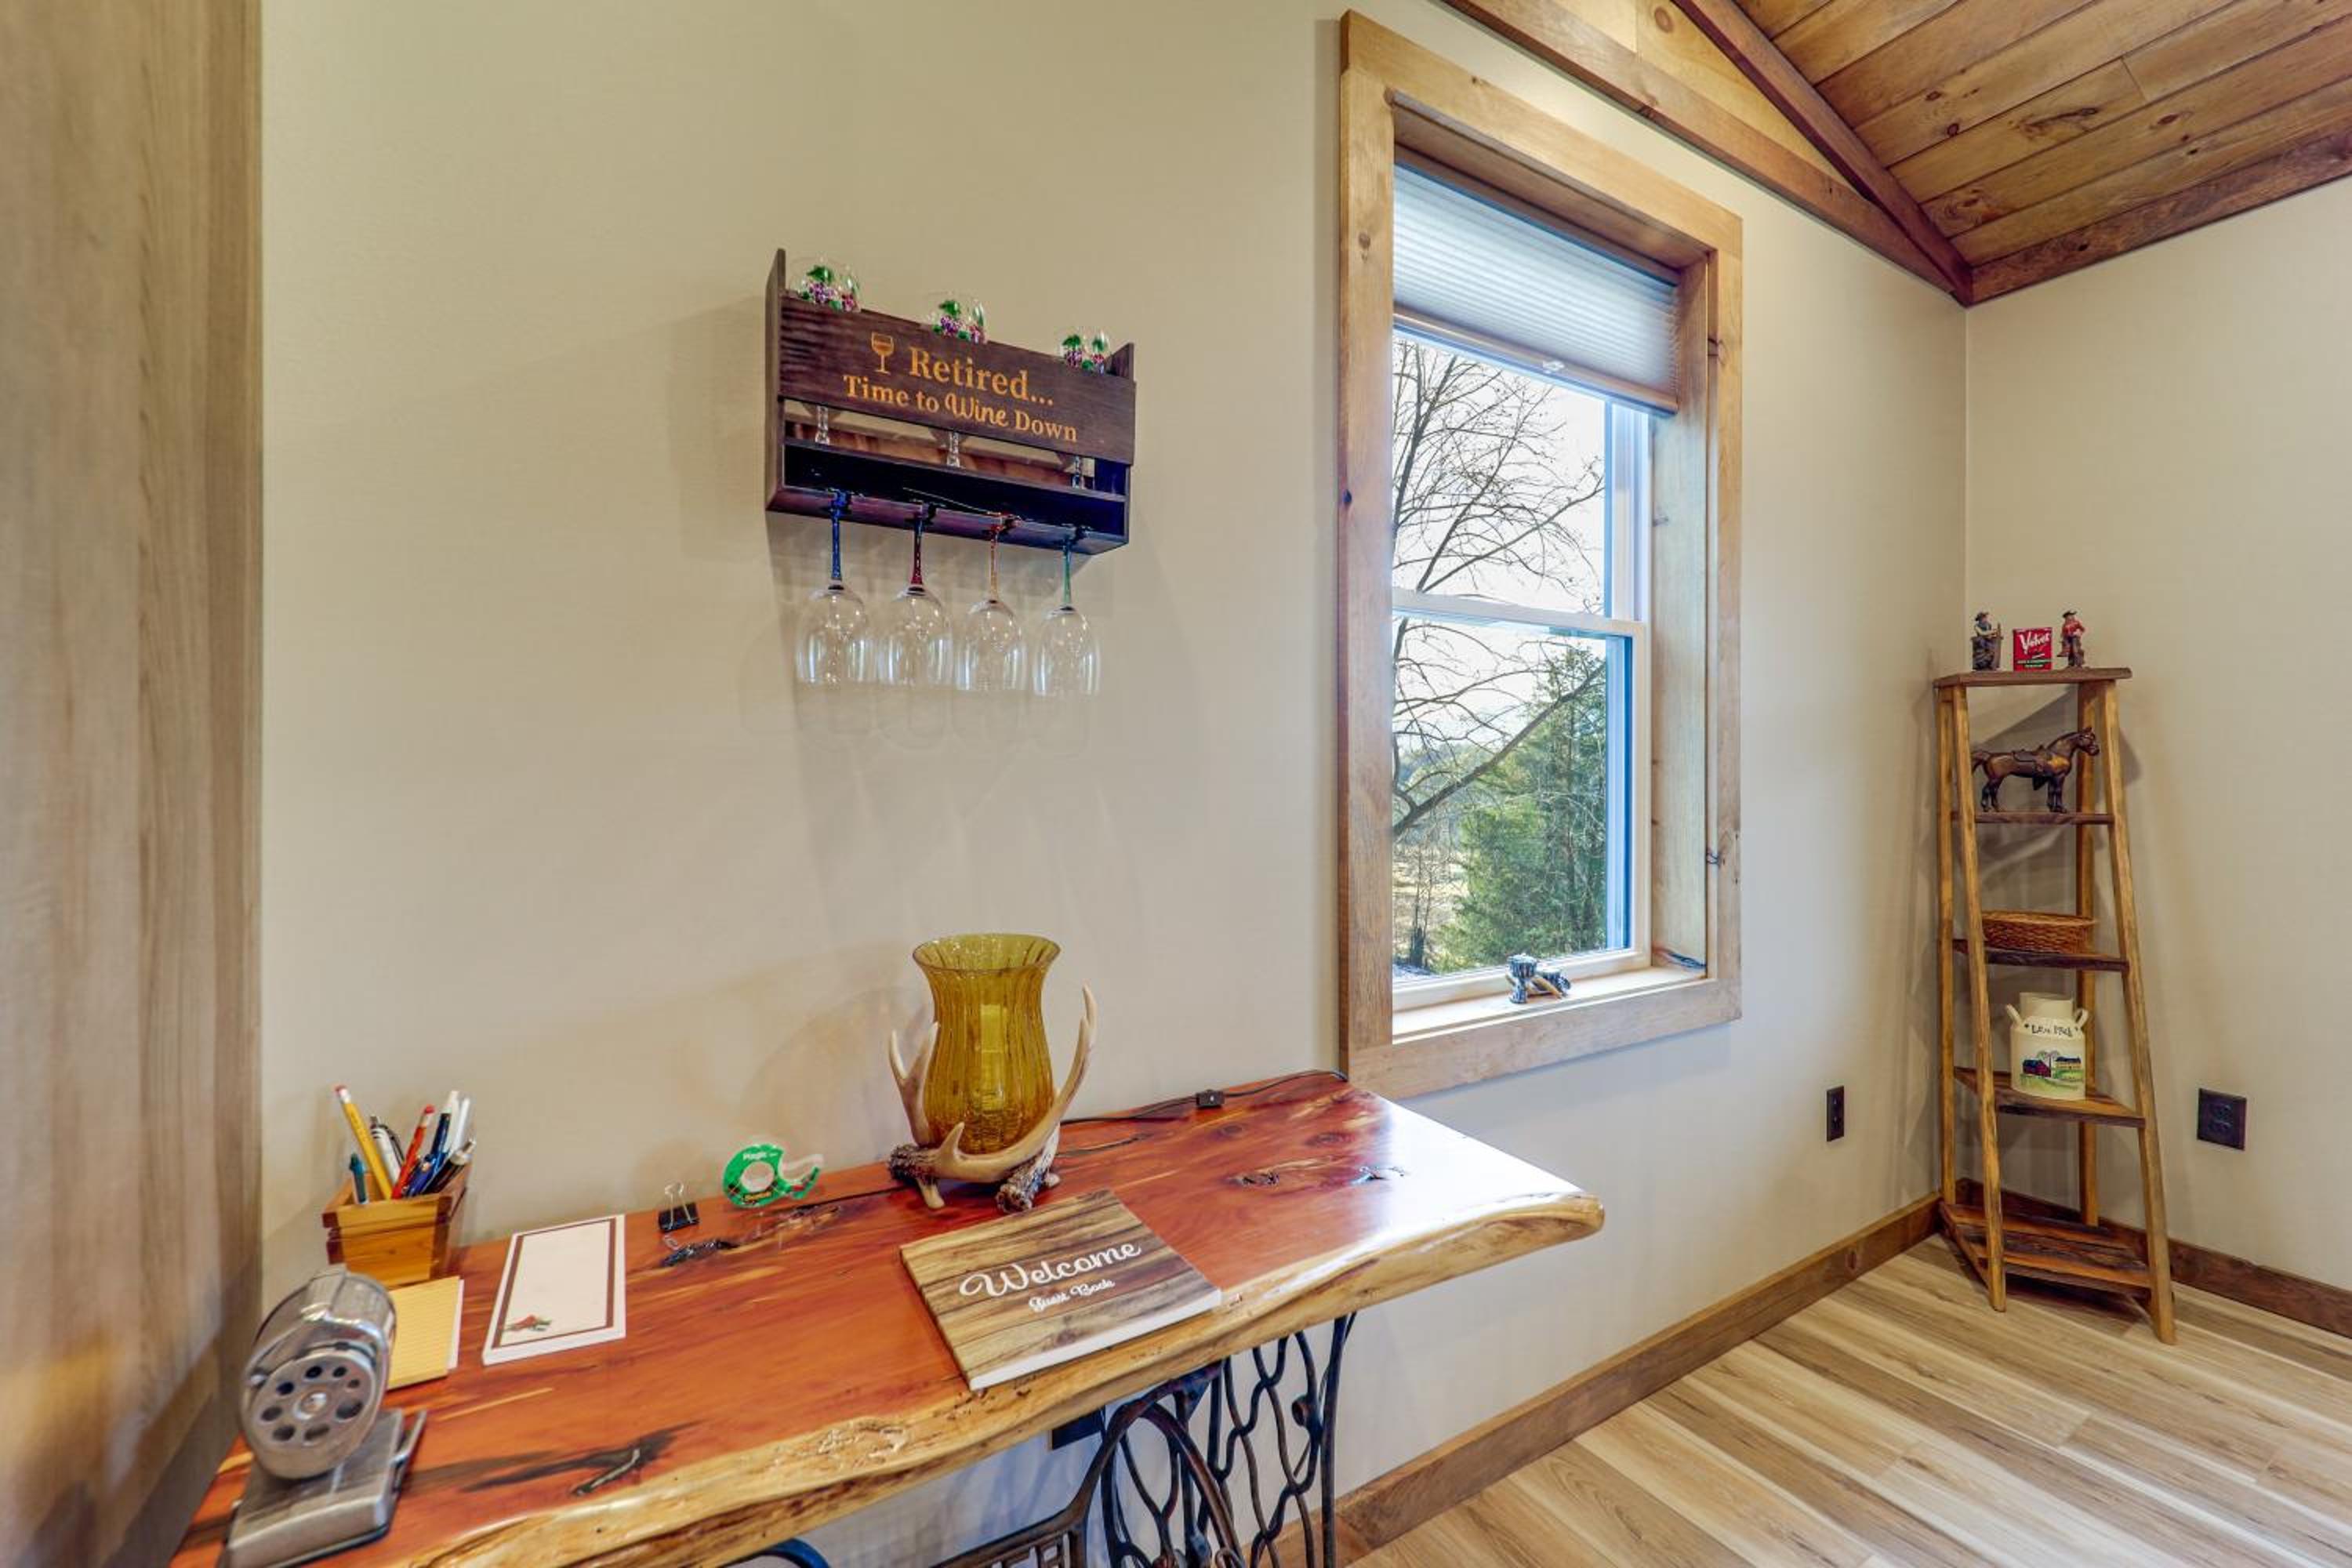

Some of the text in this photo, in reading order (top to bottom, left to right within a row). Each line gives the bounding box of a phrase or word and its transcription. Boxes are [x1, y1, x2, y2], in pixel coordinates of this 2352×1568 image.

[909, 347, 1054, 407] Retired...
[844, 375, 1077, 442] Time to Wine Down
[959, 1243, 1142, 1298] Welcome
[1028, 1279, 1116, 1312] Guest Book
